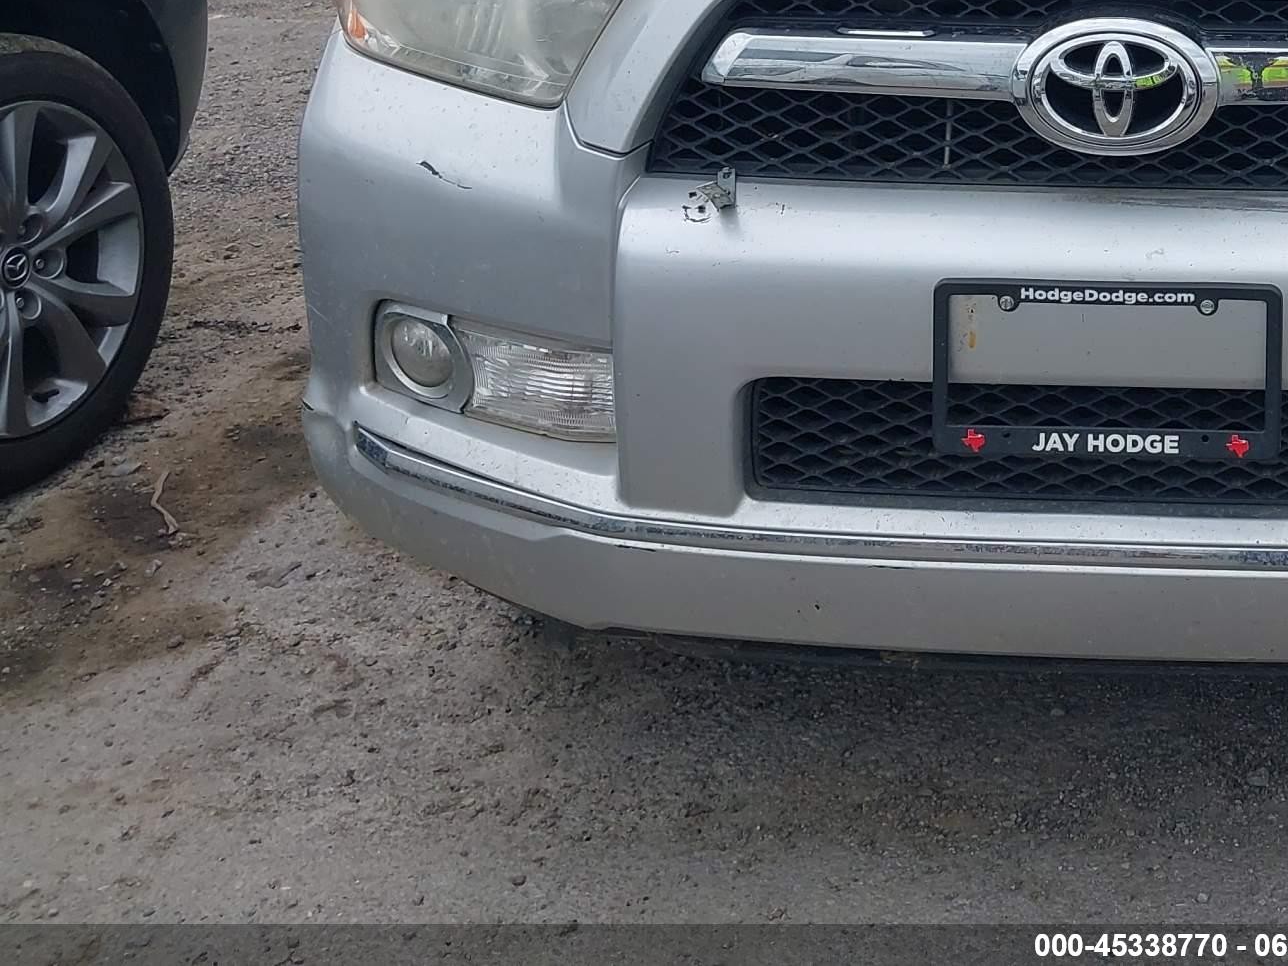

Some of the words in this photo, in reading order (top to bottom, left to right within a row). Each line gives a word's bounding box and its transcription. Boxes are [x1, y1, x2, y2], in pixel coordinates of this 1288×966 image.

[1020, 287, 1195, 304] HodgeDodge.com
[1032, 432, 1080, 452] JAY
[1088, 433, 1180, 455] HODGE
